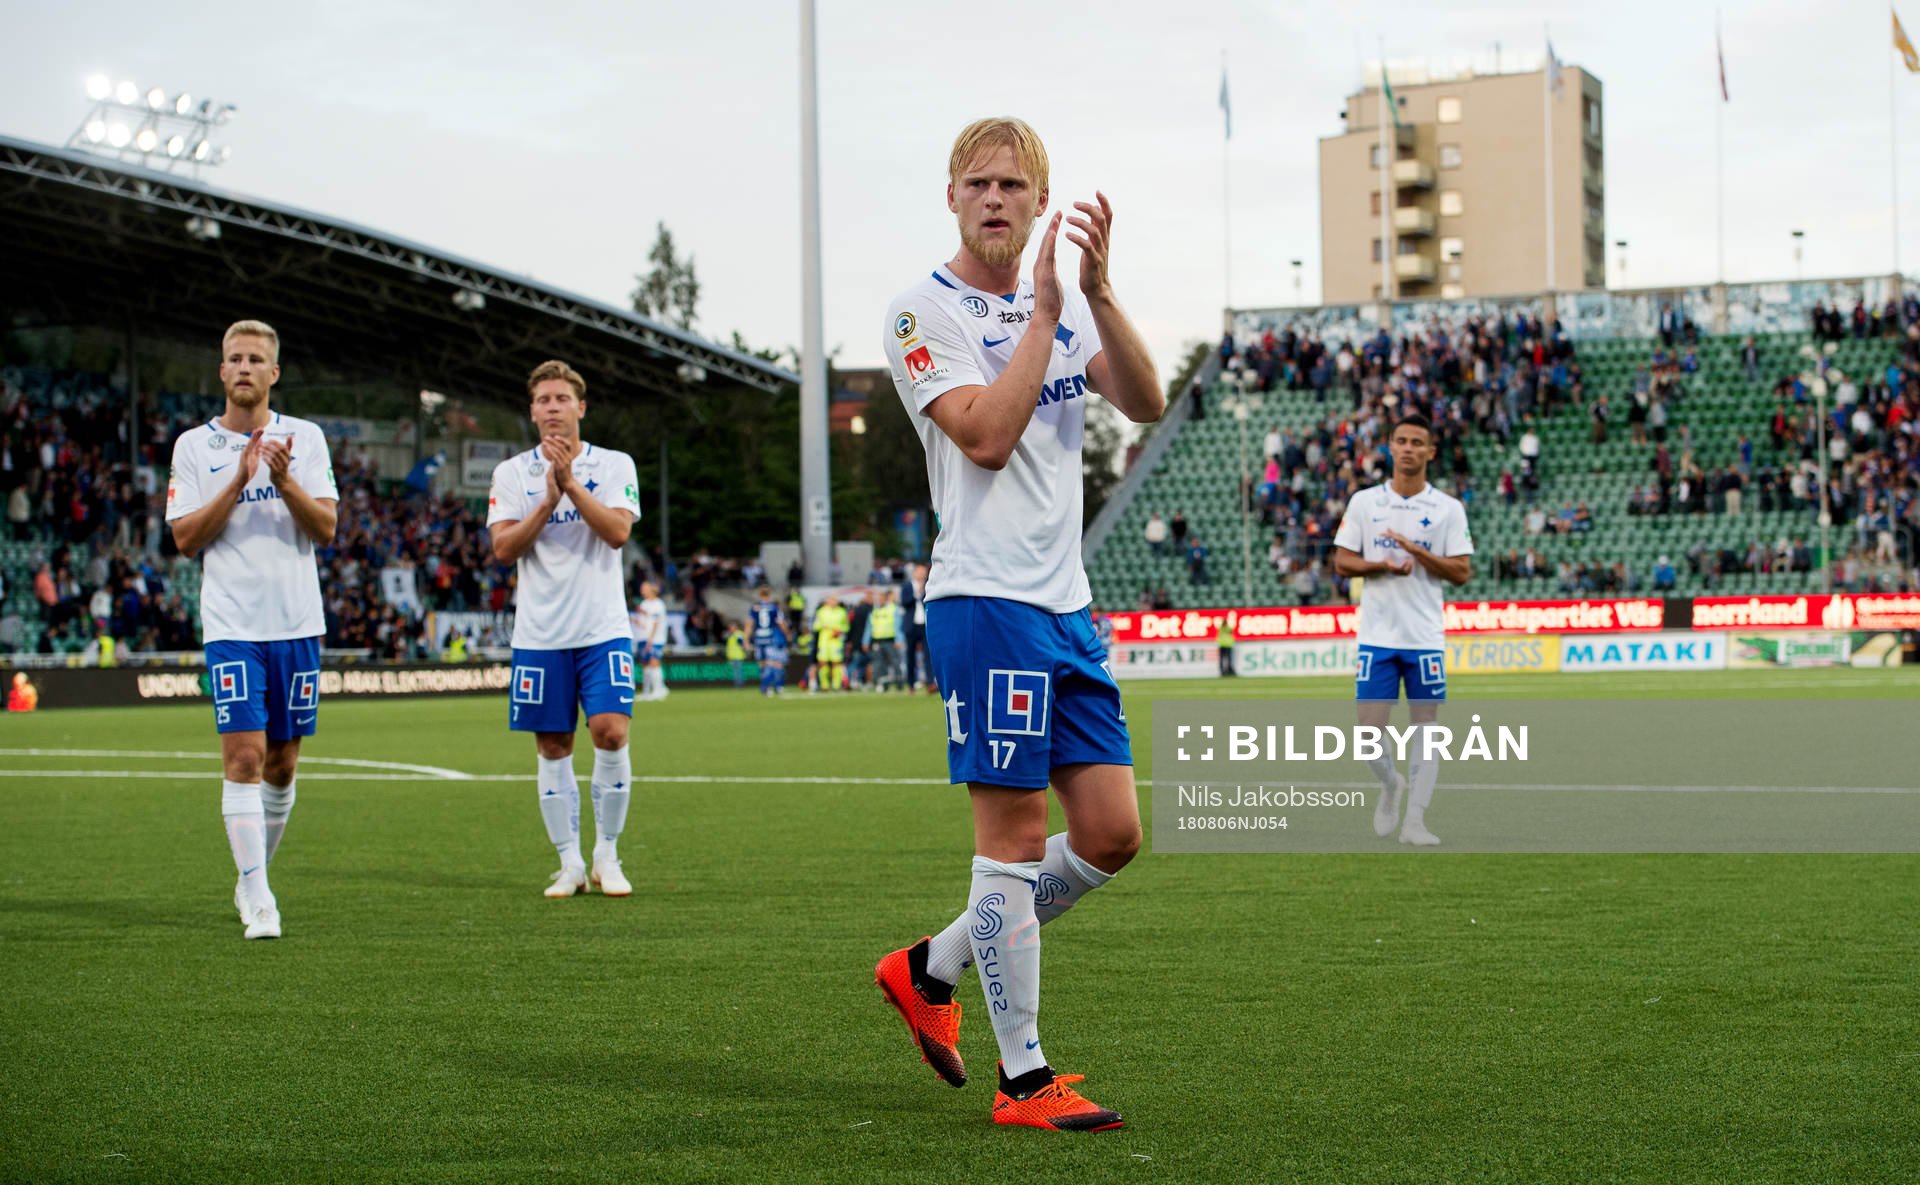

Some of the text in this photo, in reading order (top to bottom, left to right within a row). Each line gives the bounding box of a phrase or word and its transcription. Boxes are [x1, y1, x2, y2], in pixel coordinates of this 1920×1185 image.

[1036, 374, 1087, 406] MEN
[1140, 614, 1182, 638] Det
[1237, 614, 1288, 636] som
[1289, 608, 1335, 634] kan
[1243, 644, 1358, 672] skandi
[1468, 640, 1543, 668] GROSS
[1566, 642, 1711, 663] MATAKI
[216, 705, 231, 724] 25
[988, 740, 1017, 770] 17
